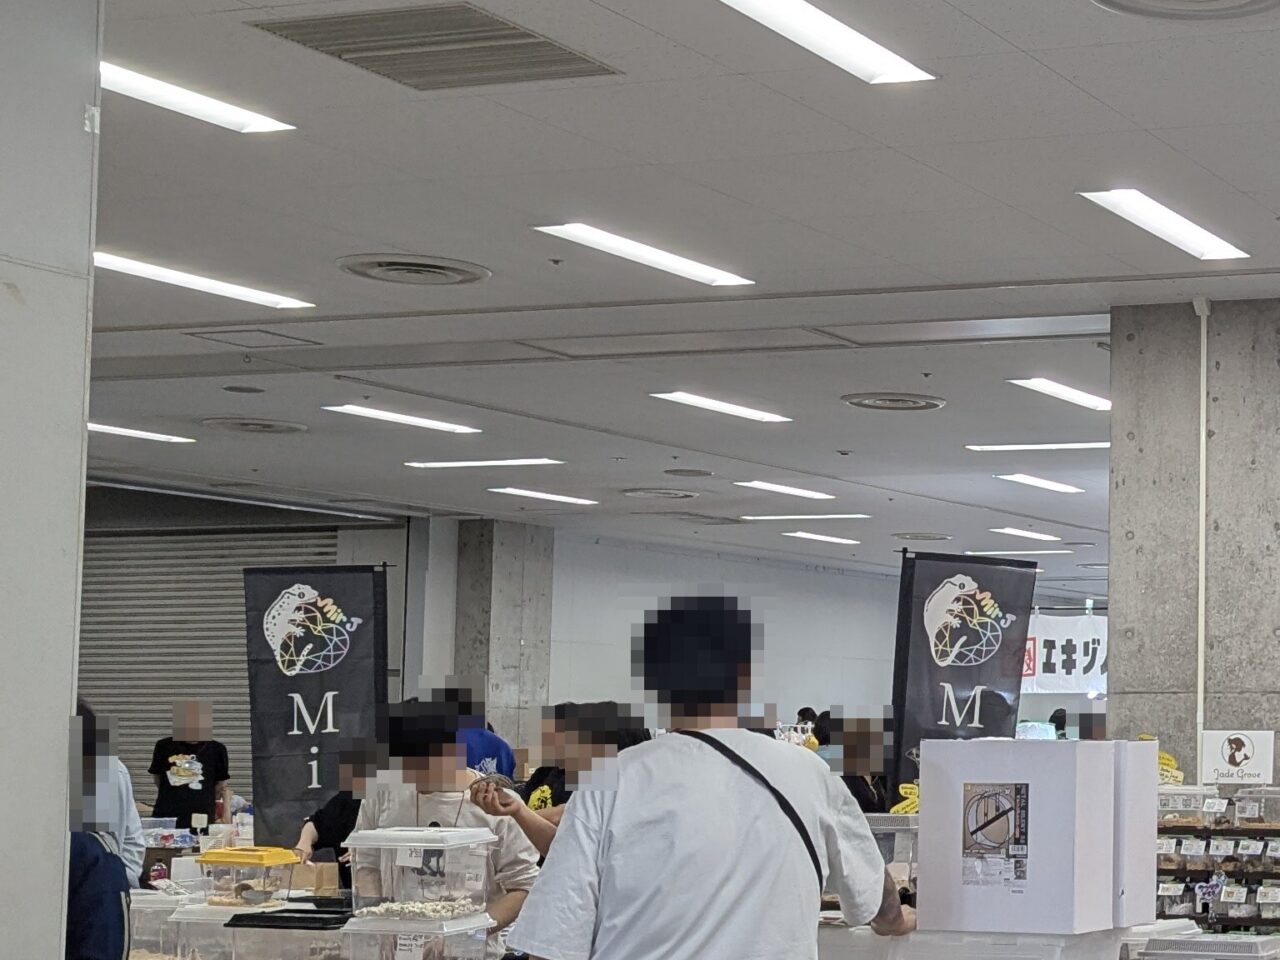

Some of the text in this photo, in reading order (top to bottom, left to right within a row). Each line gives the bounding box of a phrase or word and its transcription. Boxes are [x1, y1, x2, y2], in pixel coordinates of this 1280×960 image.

[317, 596, 346, 624] Mir
[976, 589, 1003, 619] Mir
[1213, 768, 1261, 780] Jade Grove
